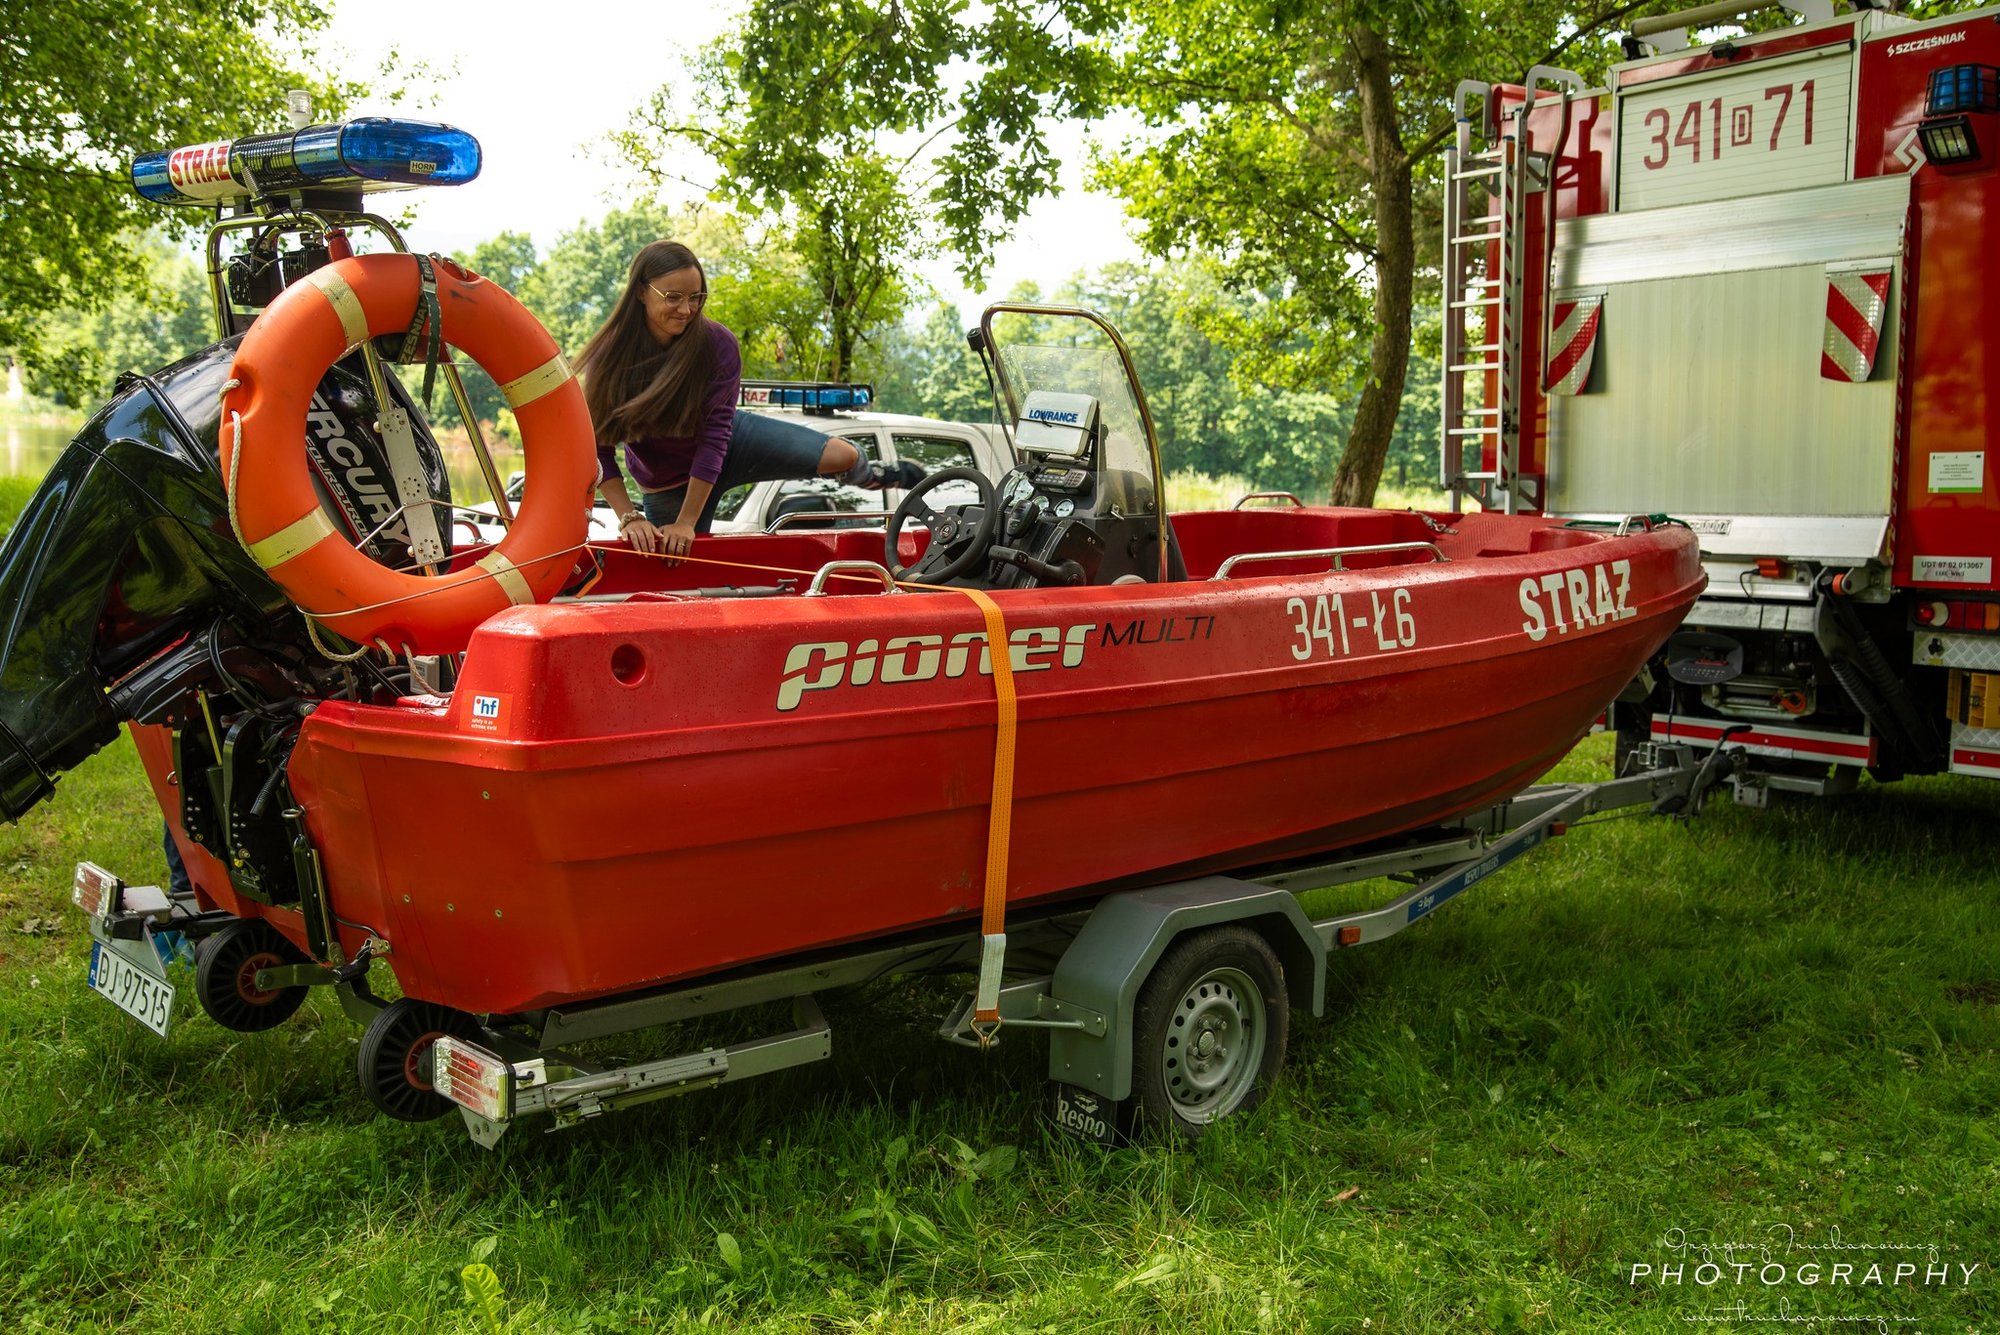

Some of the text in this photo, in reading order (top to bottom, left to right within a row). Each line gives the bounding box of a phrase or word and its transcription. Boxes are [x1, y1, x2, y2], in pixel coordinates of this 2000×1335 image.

[1895, 31, 1966, 54] SZCZĘŚNIAK
[412, 162, 435, 170] HORN
[1029, 409, 1078, 422] LOWRANCE
[306, 391, 411, 546] ERCURY
[1286, 588, 1416, 661] 341-Ł6
[776, 616, 1215, 711] pioner MULTI
